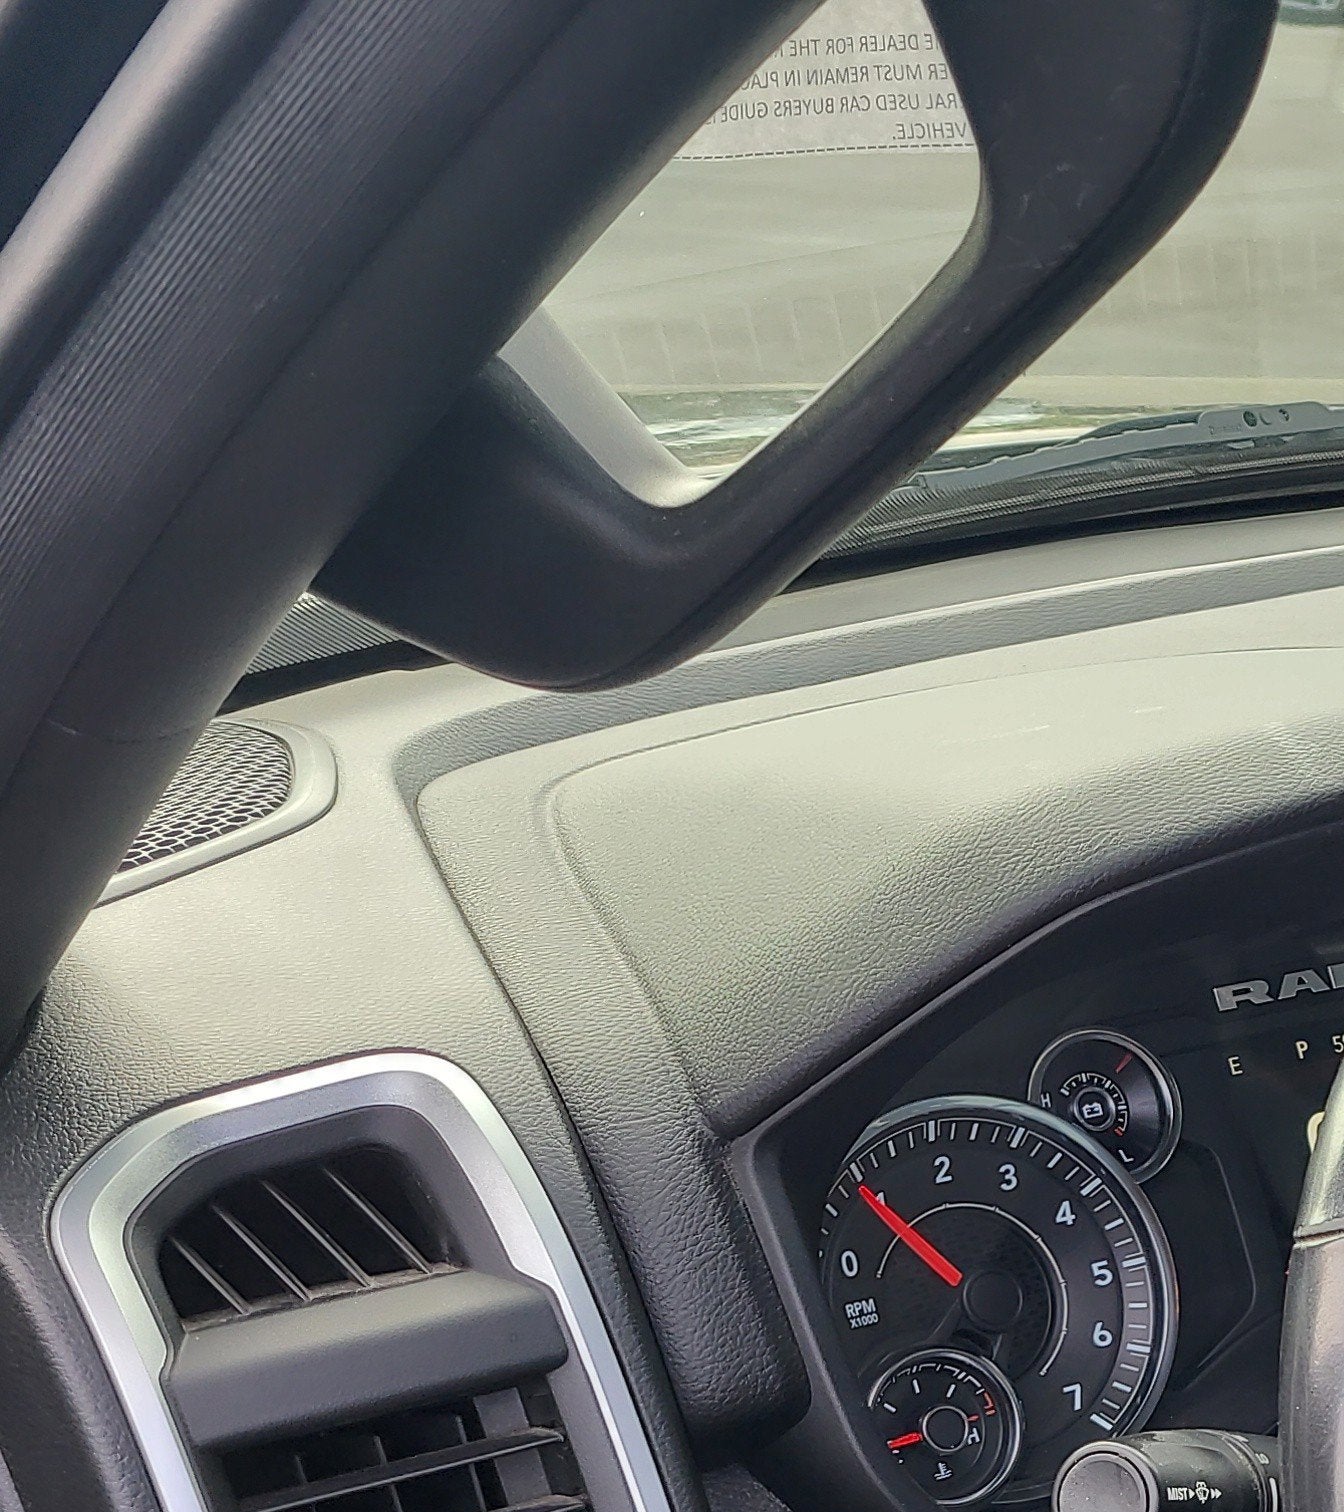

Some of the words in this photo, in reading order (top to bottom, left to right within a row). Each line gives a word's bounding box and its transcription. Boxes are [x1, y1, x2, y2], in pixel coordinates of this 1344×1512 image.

[1295, 1040, 1309, 1060] P
[1227, 1056, 1243, 1076] E
[934, 1156, 952, 1184] 2
[999, 1164, 1018, 1191] 3
[1055, 1200, 1076, 1226] 4
[840, 1250, 859, 1278] 0
[1091, 1260, 1114, 1286] 5
[844, 1298, 876, 1318] RPM
[849, 1313, 879, 1329] X1000
[1092, 1321, 1113, 1348] 6
[1063, 1383, 1082, 1411] 7
[1167, 1487, 1188, 1501] MIST
